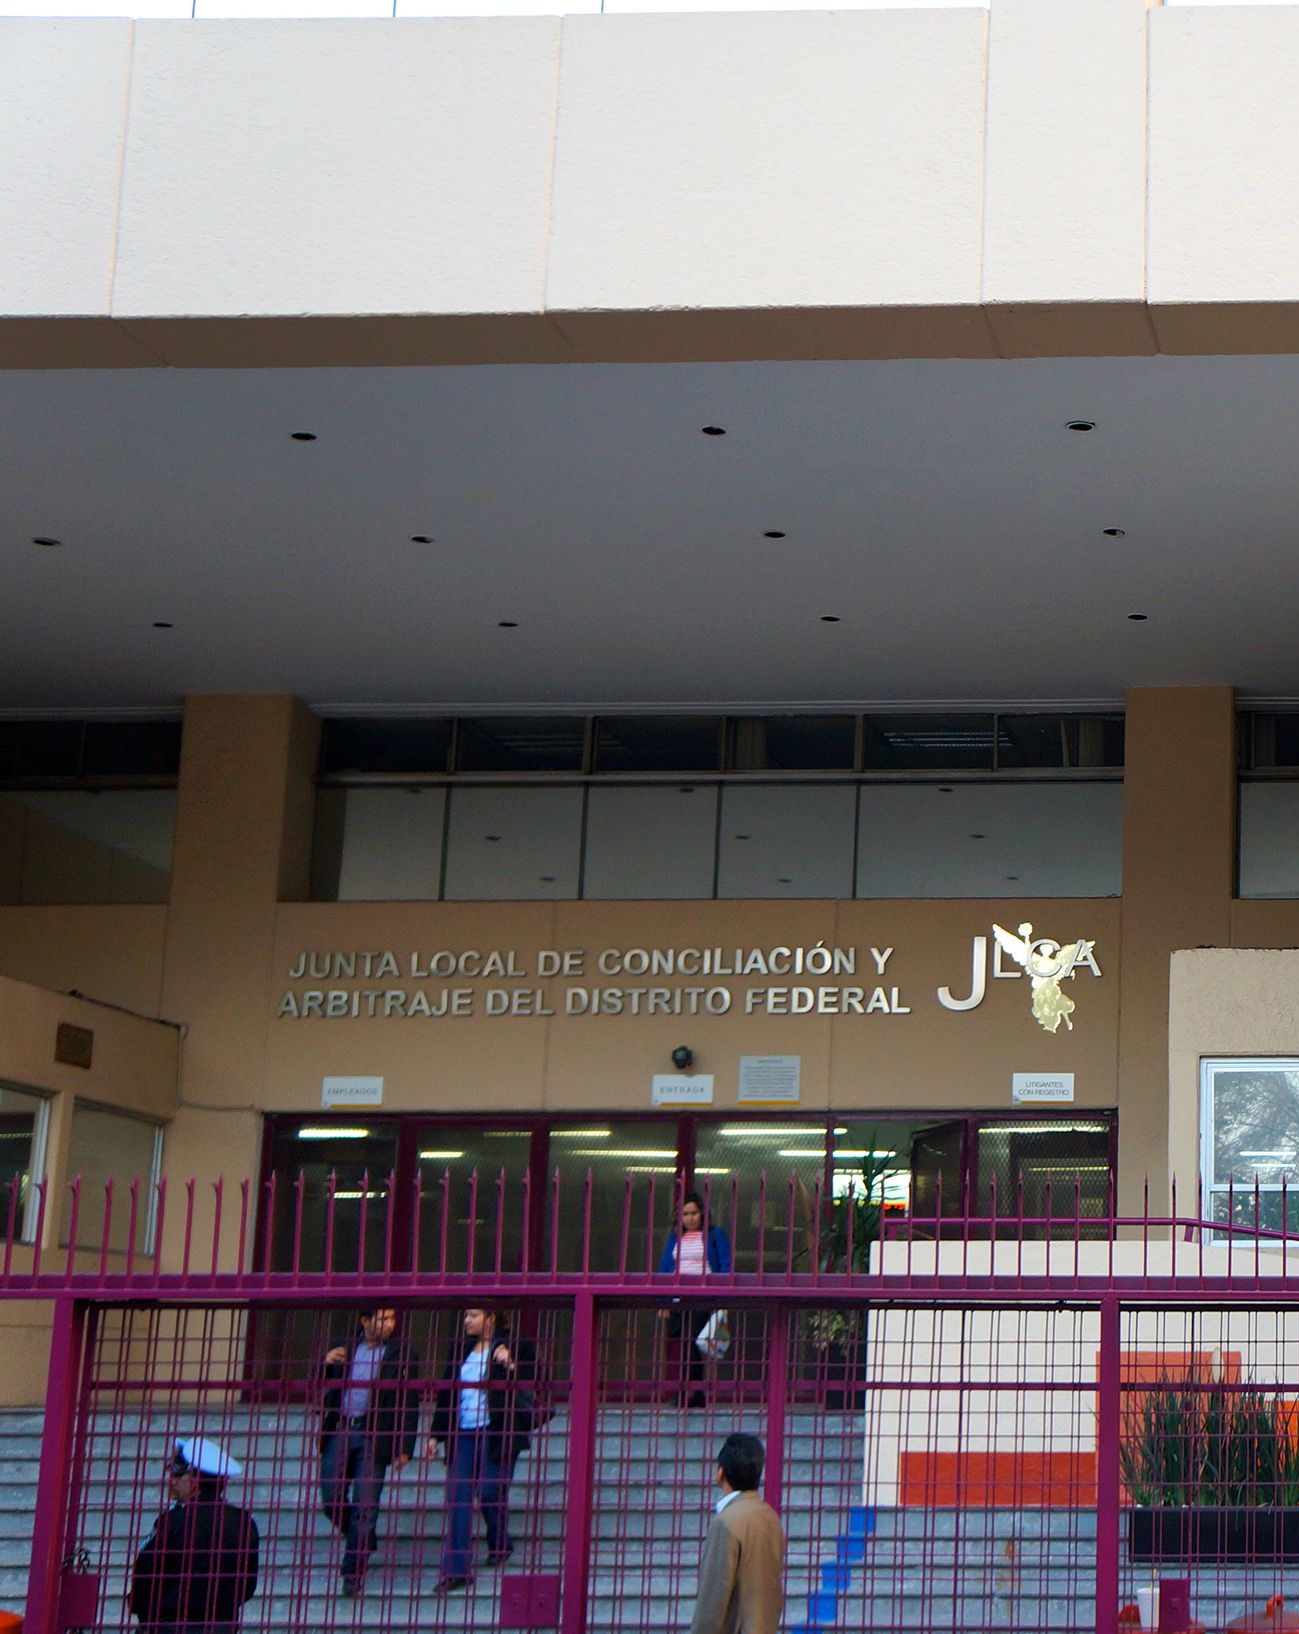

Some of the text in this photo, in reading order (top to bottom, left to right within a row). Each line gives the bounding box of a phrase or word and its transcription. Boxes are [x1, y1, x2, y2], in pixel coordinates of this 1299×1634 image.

[289, 939, 894, 979] JUNTA LOCAL DE CONCILIACIÓN Y
[278, 985, 911, 1019] ARBITRAJE DEL DISTRITO FEDERAL
[660, 1086, 705, 1094] ENTRADA
